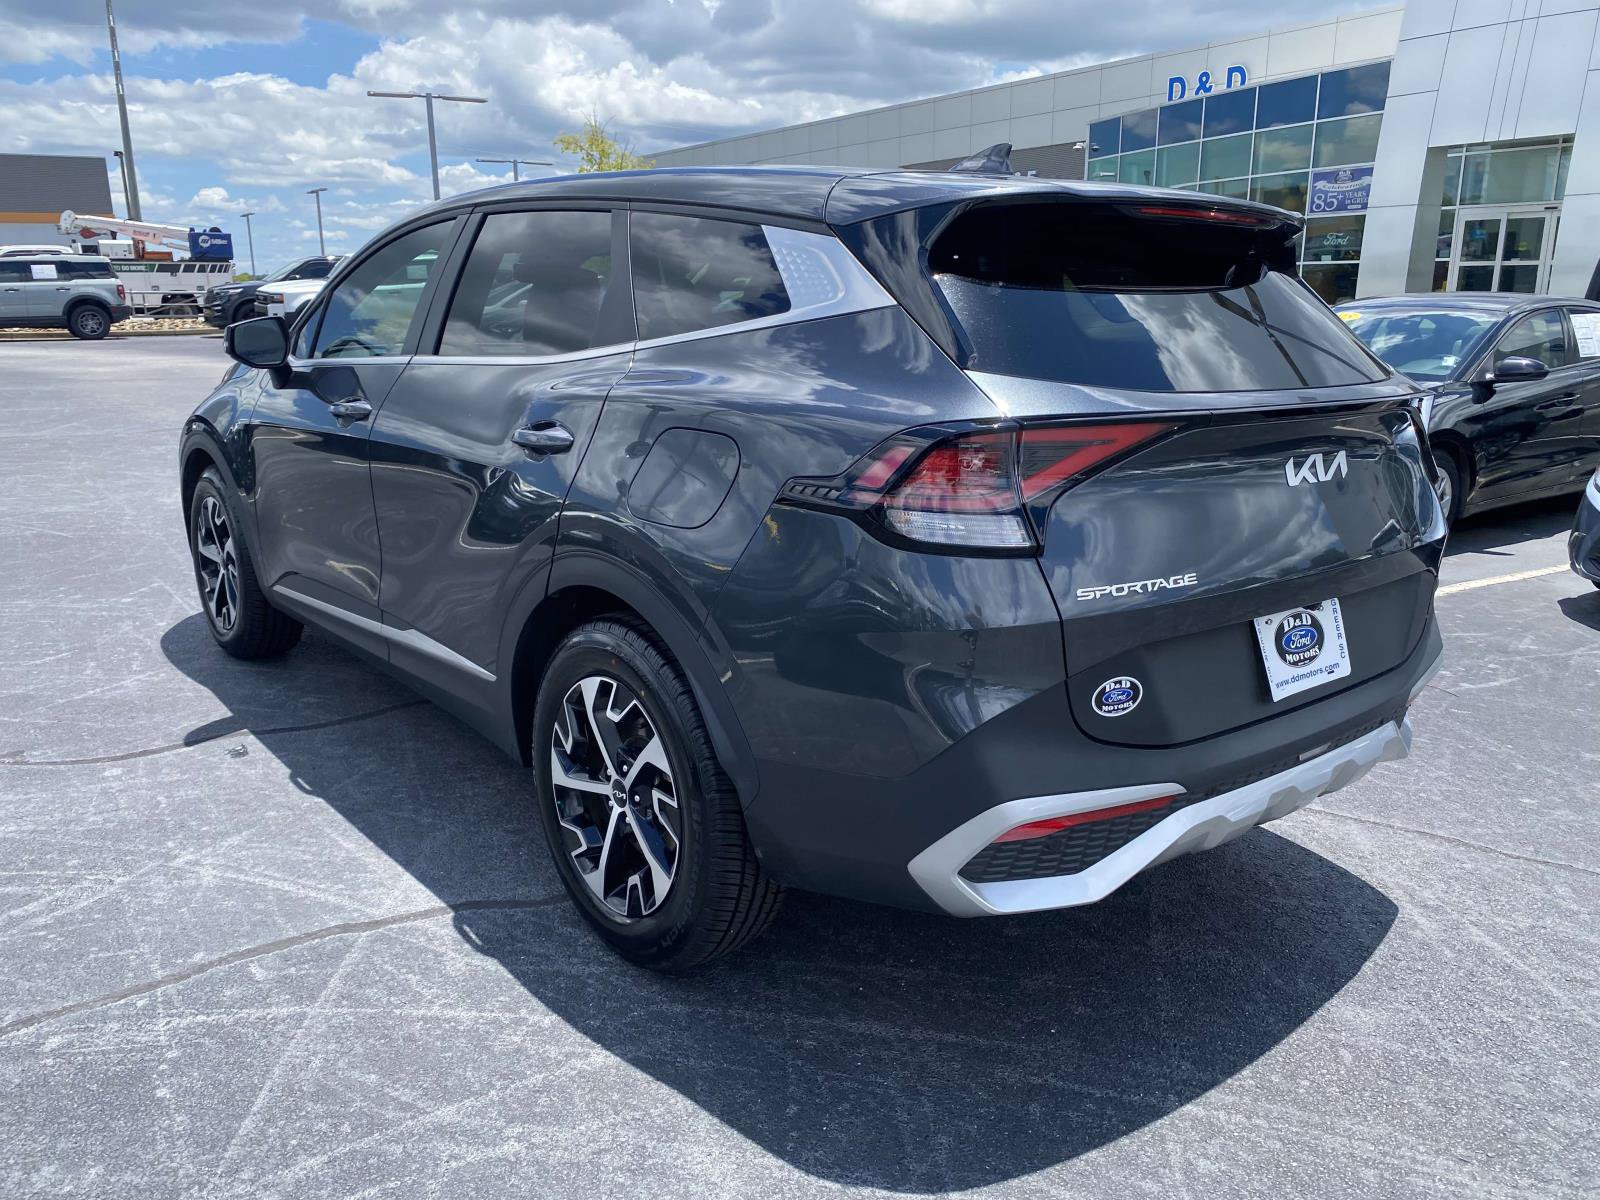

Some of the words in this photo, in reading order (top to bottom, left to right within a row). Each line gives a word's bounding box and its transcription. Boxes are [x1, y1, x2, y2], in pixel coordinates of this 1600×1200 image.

[1168, 76, 1187, 102] D
[1194, 71, 1214, 96] &
[1225, 65, 1247, 89] D
[1312, 191, 1344, 212] 85+
[1345, 191, 1367, 199] YEARS
[1323, 232, 1350, 246] Ford
[1285, 450, 1348, 487] KIA
[1076, 573, 1198, 601] SPORTAGE
[1283, 613, 1312, 633] D&D
[1330, 598, 1344, 640] GREER
[1338, 644, 1346, 659] SC
[1290, 630, 1311, 649] Ford
[1285, 645, 1320, 664] MOTORS
[1275, 662, 1340, 689] www.ddmotors.com
[1105, 680, 1131, 692] D&D
[1101, 700, 1134, 712] MOTORS
[1108, 691, 1128, 702] Ford
